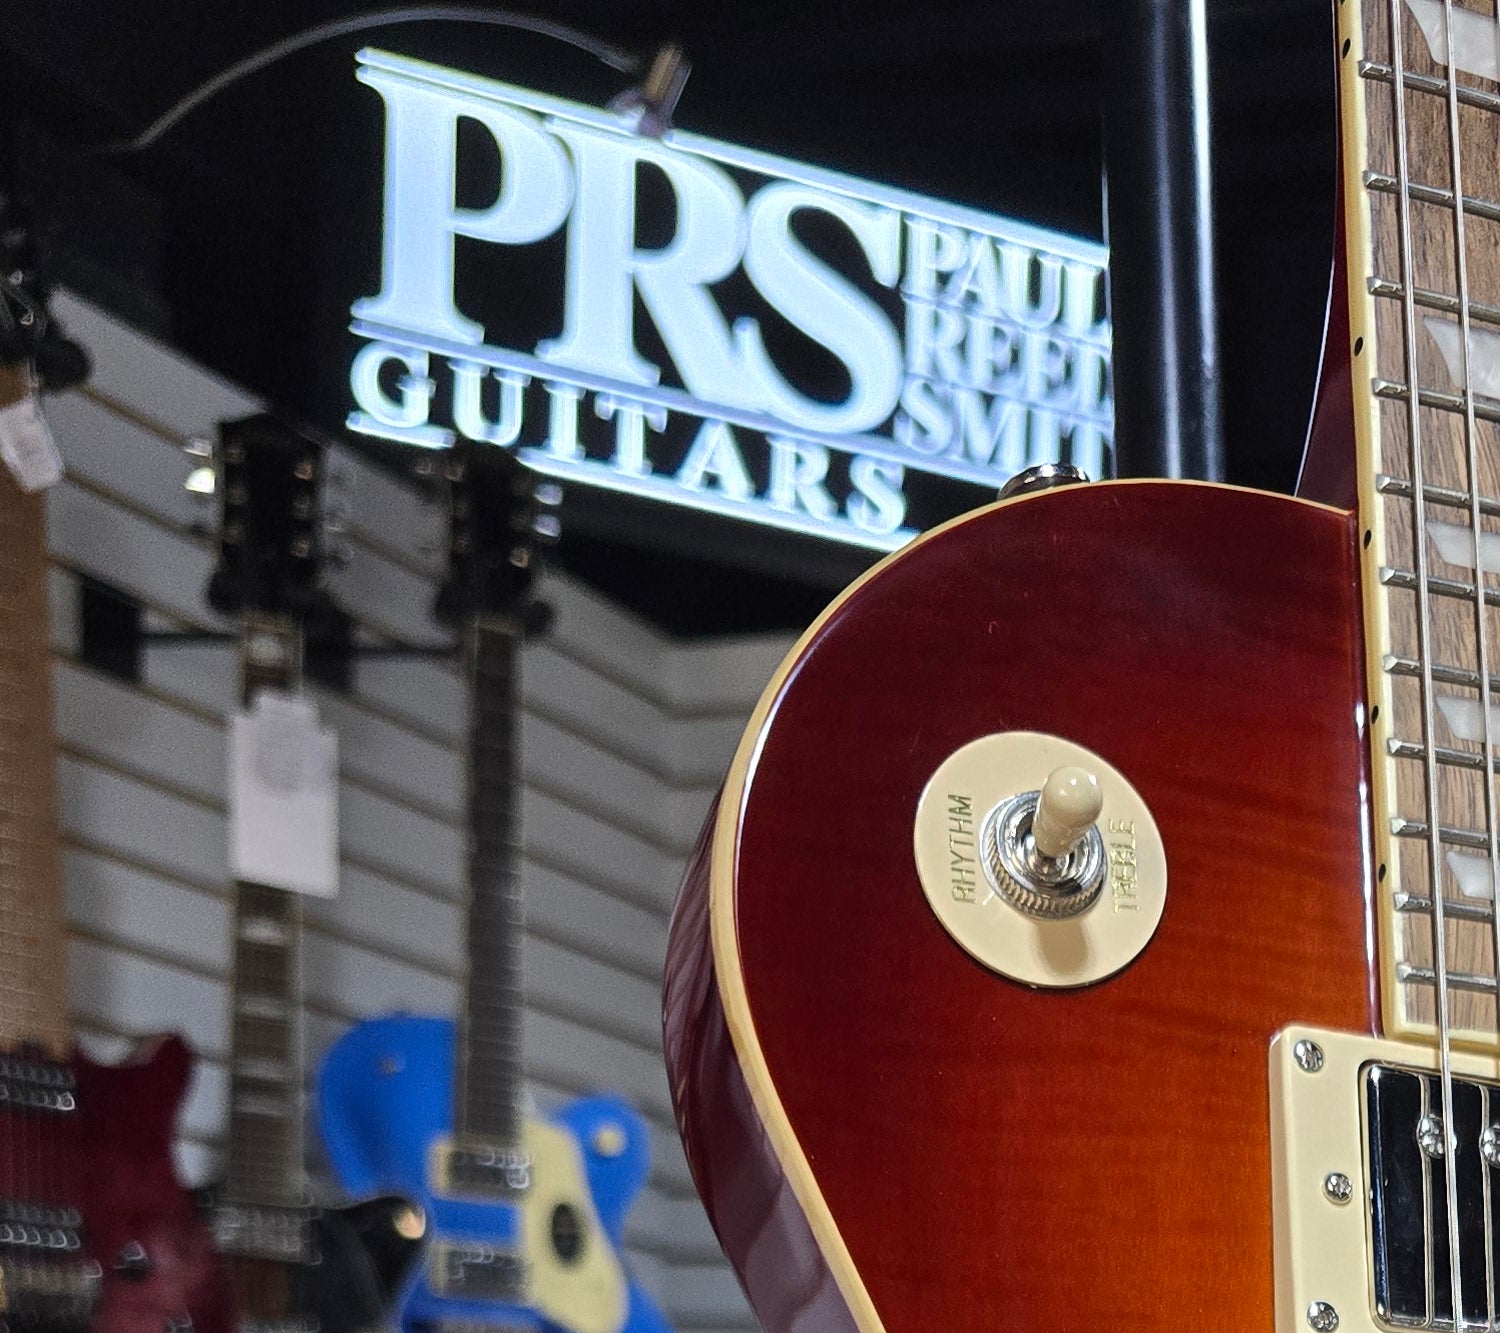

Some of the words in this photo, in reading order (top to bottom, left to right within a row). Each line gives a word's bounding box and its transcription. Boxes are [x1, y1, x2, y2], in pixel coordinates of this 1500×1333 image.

[350, 64, 903, 434] PRS
[349, 340, 908, 536] GUITARS
[947, 793, 977, 904] RHYTHM
